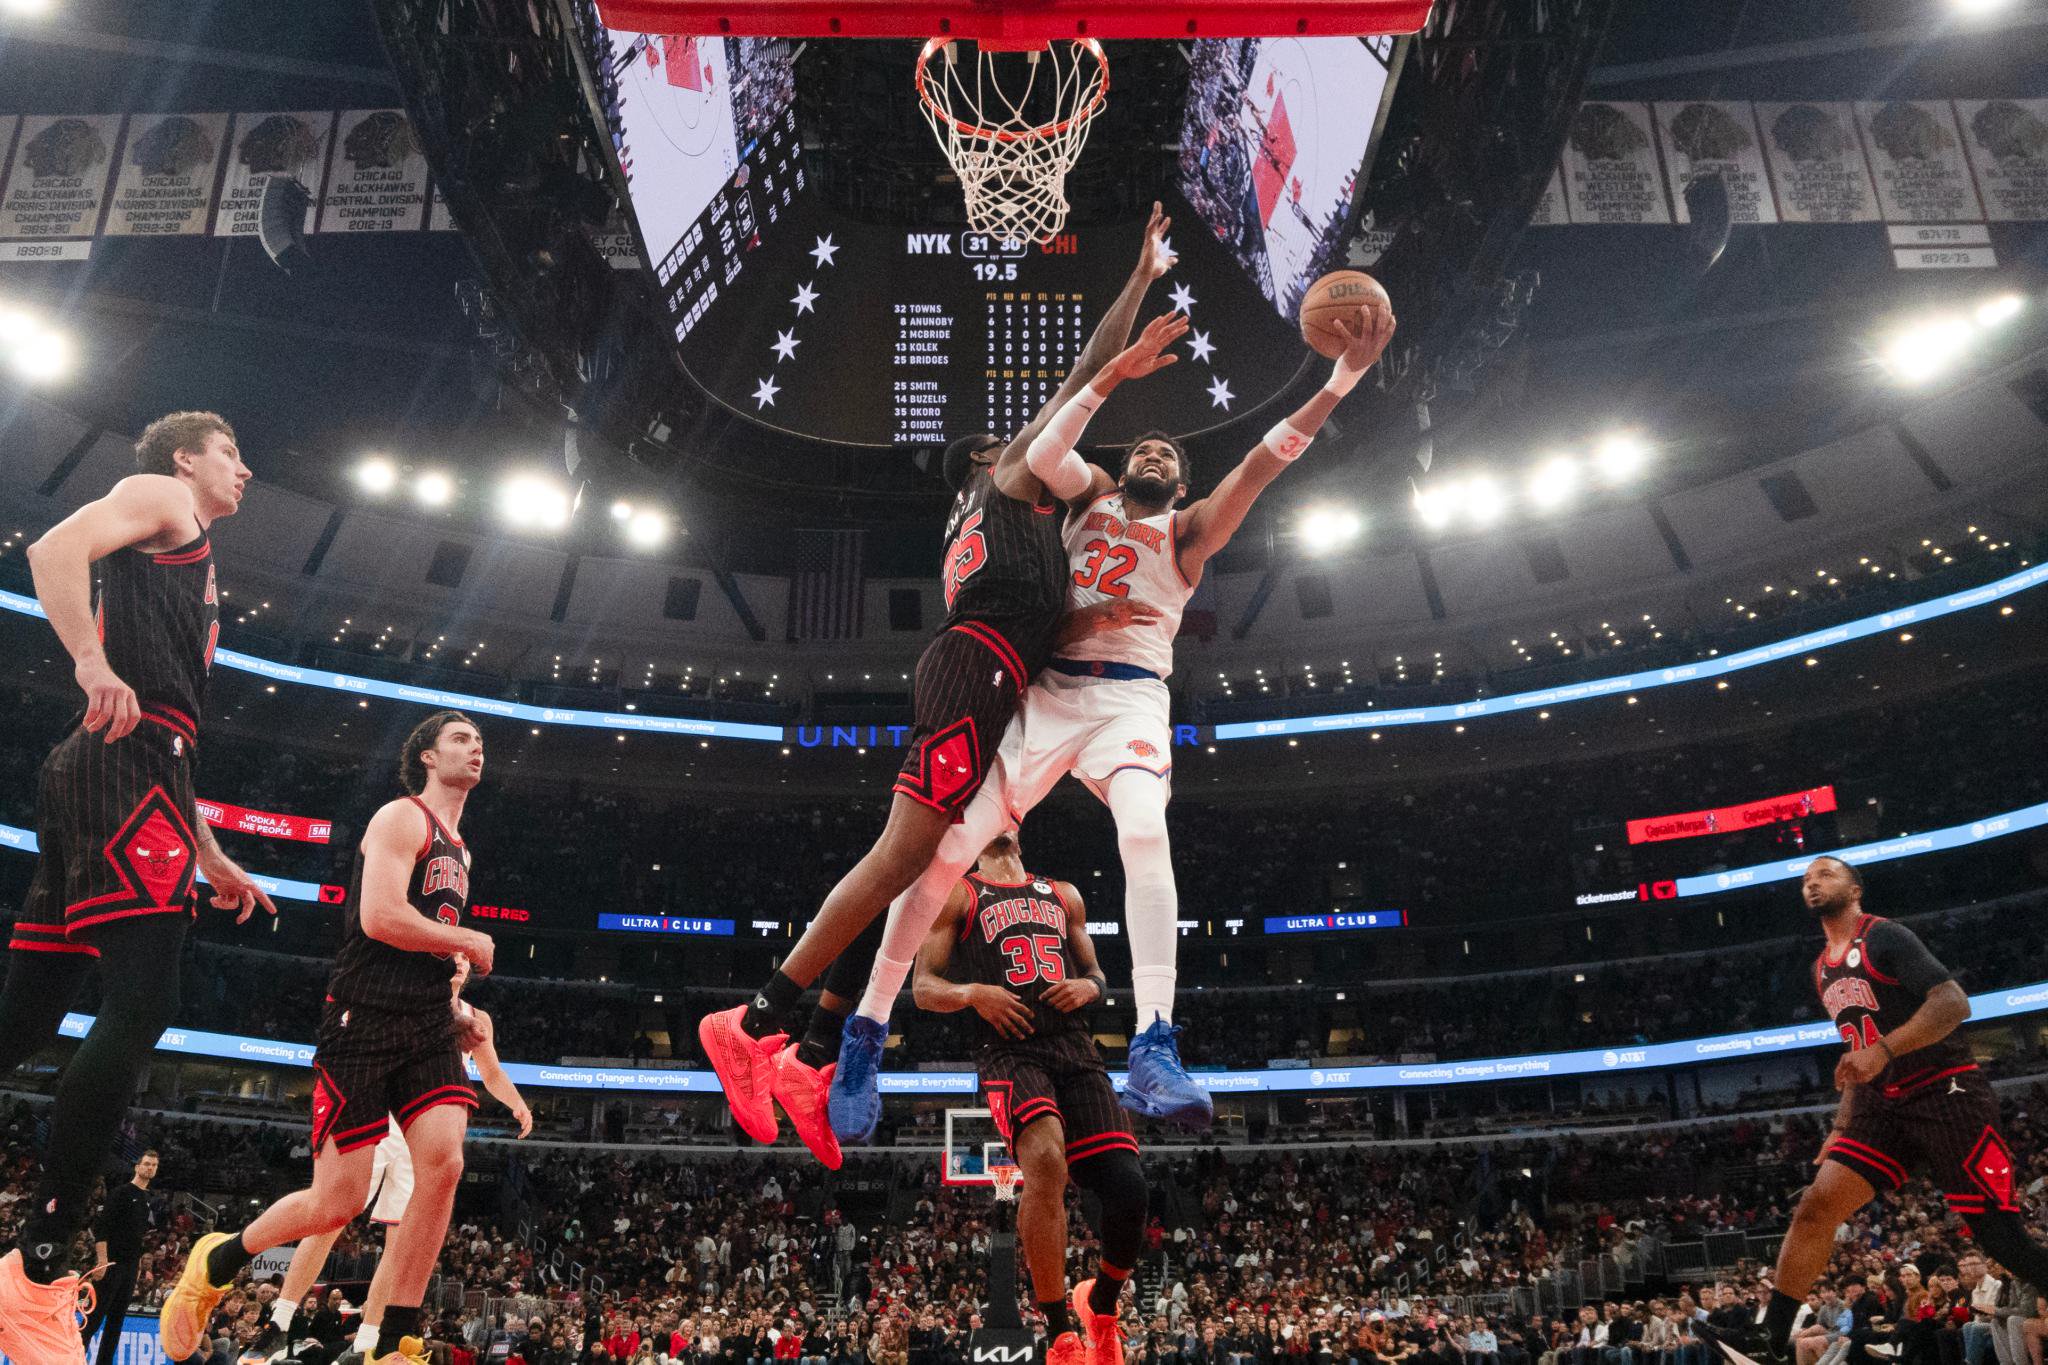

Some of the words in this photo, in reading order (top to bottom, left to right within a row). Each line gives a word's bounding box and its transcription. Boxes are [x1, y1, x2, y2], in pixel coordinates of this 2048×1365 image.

[353, 171, 402, 181] CHICAGO
[337, 183, 415, 193] BLACKHAWKS
[339, 208, 406, 217] CHAMPIONS
[348, 220, 393, 230] 2012-13
[908, 233, 952, 255] NYK
[969, 237, 988, 251] 31
[1000, 237, 1020, 251] 30
[1041, 236, 1077, 254] CHI
[972, 262, 1018, 281] 19.5
[894, 304, 907, 314] 32
[909, 304, 942, 314] TOWNS
[909, 316, 954, 327] ANUNOBY
[909, 329, 951, 340] MCBRIDE
[894, 342, 908, 352] 13
[909, 342, 939, 352] KOLEK
[893, 355, 908, 365] 25
[909, 355, 949, 365] BRIDGES
[893, 381, 908, 391] 25
[909, 381, 938, 391] SMITH
[894, 394, 908, 404] 14
[909, 394, 948, 404] BUZELIS
[894, 407, 908, 417] 35
[909, 407, 941, 417] OKORO
[909, 420, 944, 430] GIDDEY
[893, 432, 908, 442] 24
[909, 432, 946, 443] POWELL
[1081, 511, 1127, 538] NEW
[1072, 538, 1139, 599] 32
[226, 654, 258, 669] Changes
[259, 662, 302, 680] Everything
[345, 679, 369, 690] AT&T
[398, 688, 441, 702] Connecting
[442, 695, 473, 707] Changes
[473, 700, 514, 715] Everything
[554, 712, 576, 721] AT&T
[603, 716, 644, 729] Connecting
[645, 719, 676, 731] Changes
[676, 722, 716, 734] Everything
[797, 725, 909, 748] UNIT
[244, 813, 276, 826] VODKA
[1986, 818, 2009, 834] AT&T
[238, 820, 255, 832] THE
[256, 824, 292, 837] PEOPLE
[1879, 838, 1932, 856] Everything
[1730, 870, 1754, 884] AT&T
[1576, 890, 1637, 905] ticketmaster
[470, 904, 498, 919] SEE
[621, 917, 657, 929] ULTRA
[671, 919, 710, 932] CLUB
[980, 898, 1067, 943] CHICAGO
[1225, 919, 1244, 928] FOULS
[1286, 919, 1325, 930] ULTRA
[1333, 914, 1378, 928] CLUB
[1085, 922, 1119, 935] HICAGO
[1000, 933, 1066, 986] 35
[1696, 1039, 1752, 1055] Connecting
[1753, 1033, 1796, 1047] Changes
[239, 1043, 295, 1060] Connecting
[1618, 1052, 1646, 1064] AT&T
[1399, 1068, 1453, 1079] Connecting
[1455, 1065, 1495, 1077] Changes
[1496, 1060, 1550, 1073] Everything
[540, 1070, 593, 1084] Connecting
[595, 1073, 636, 1085] Changes
[638, 1075, 690, 1087] Everything
[881, 1077, 920, 1089] Changes
[922, 1077, 972, 1089] Everything
[1208, 1077, 1259, 1088] Everything
[1325, 1072, 1351, 1083] AT&T
[973, 1345, 1034, 1363] KIA
